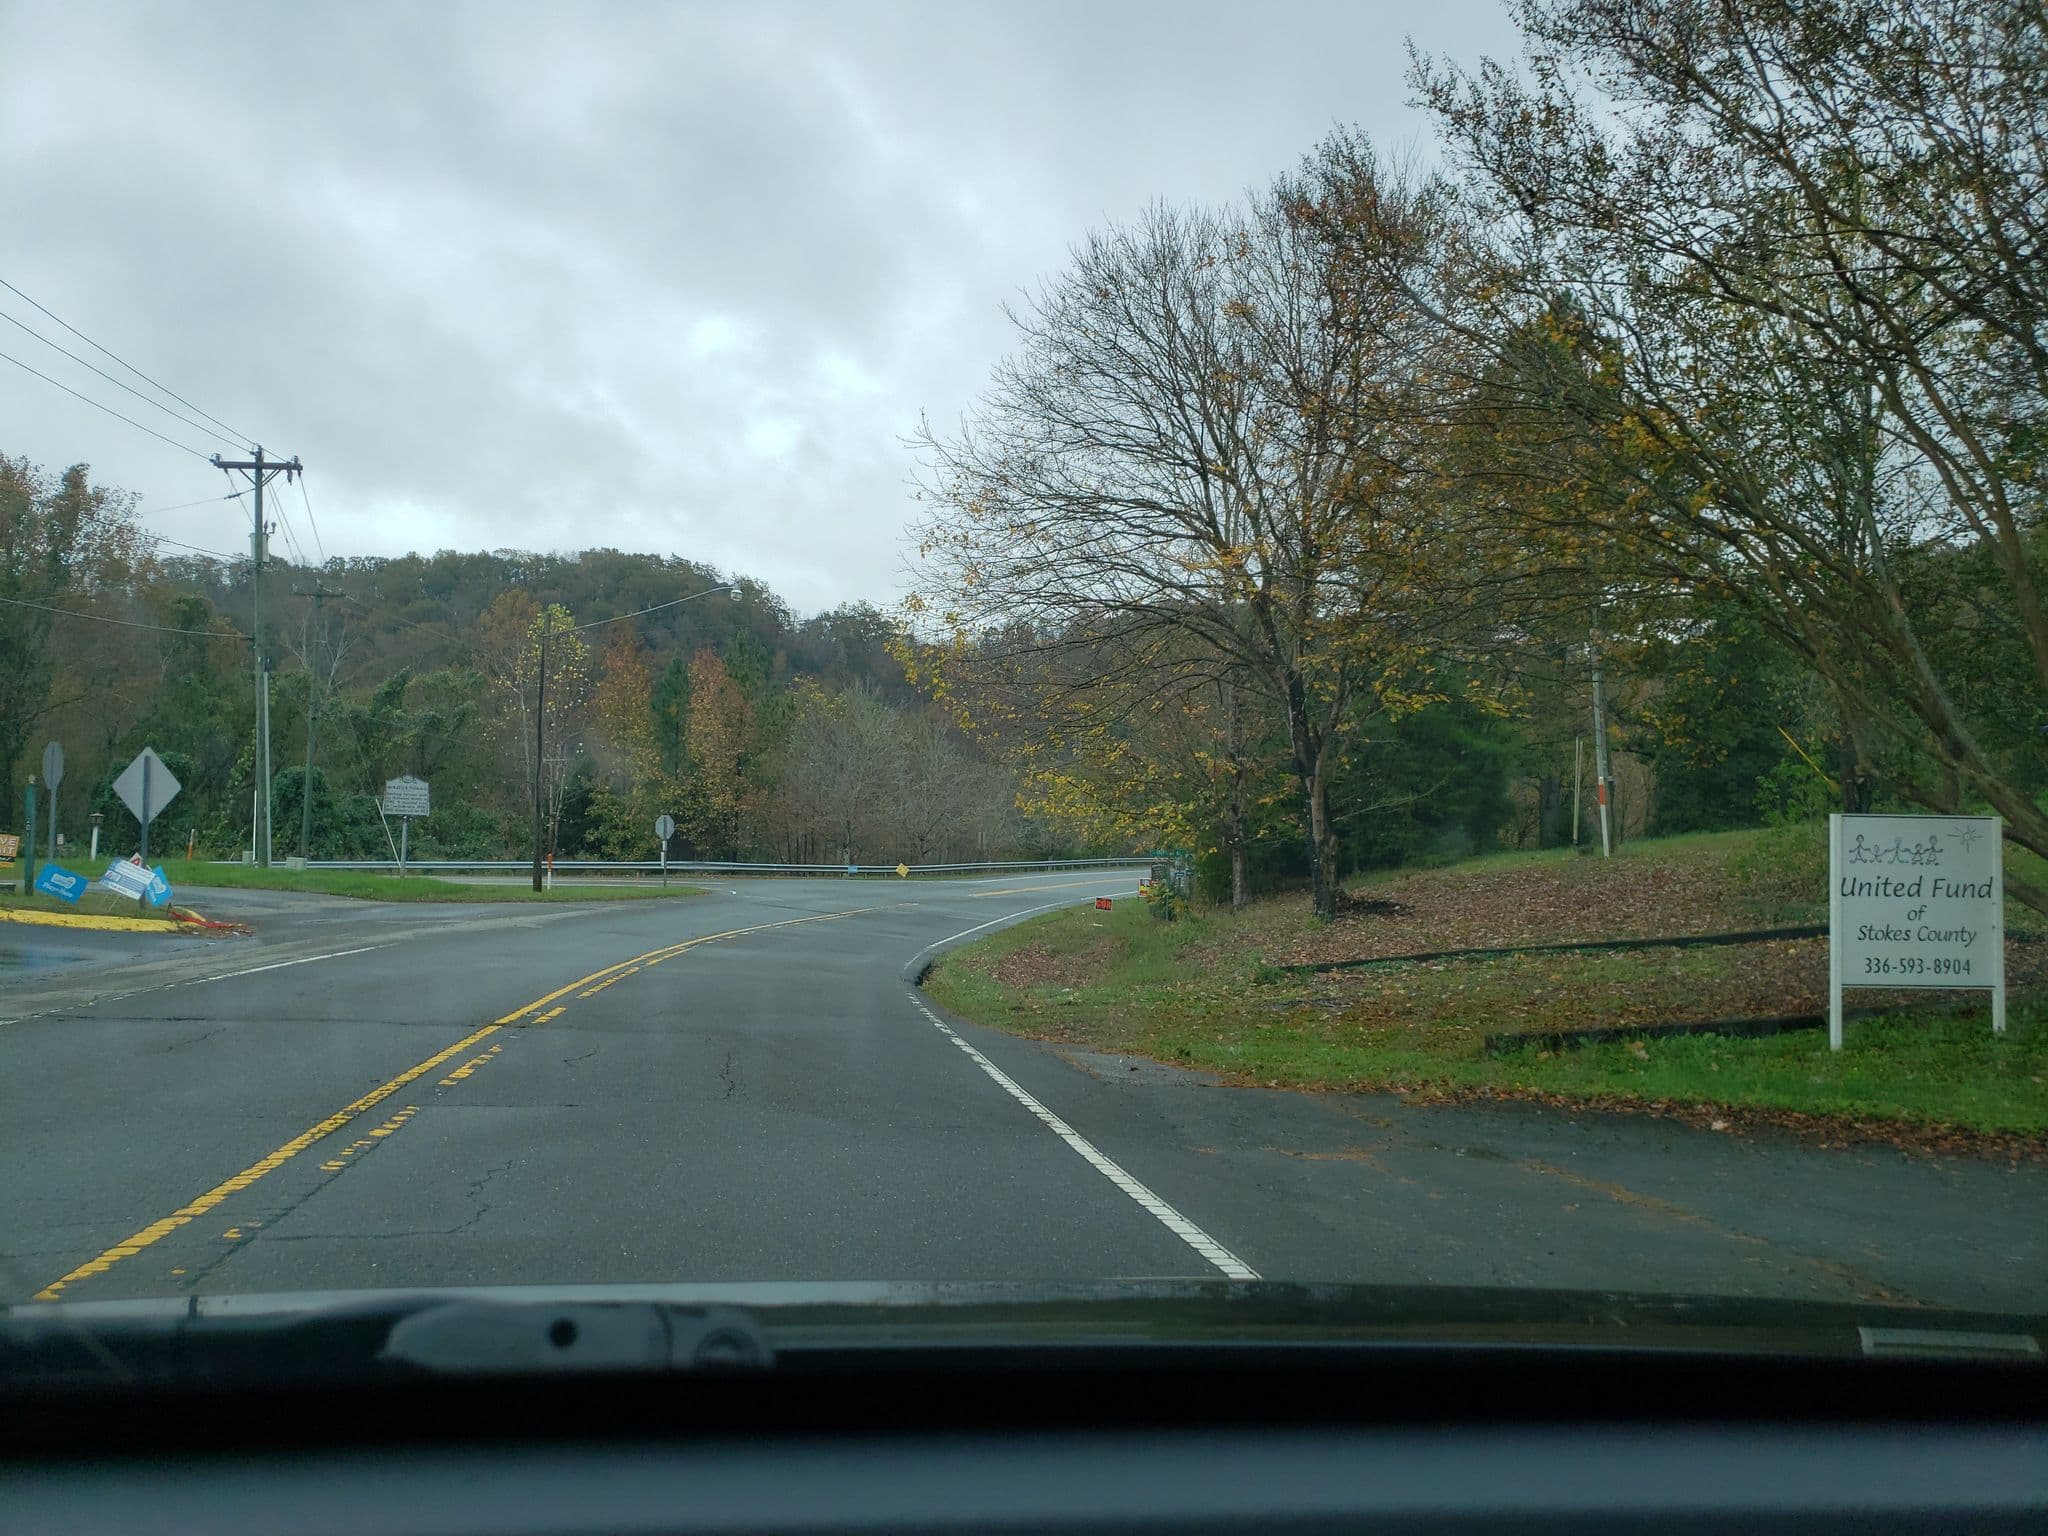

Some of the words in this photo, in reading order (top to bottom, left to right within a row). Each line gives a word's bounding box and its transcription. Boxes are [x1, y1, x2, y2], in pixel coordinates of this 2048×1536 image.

[1840, 875, 1923, 898] United
[1931, 876, 1994, 899] Fund
[1907, 905, 1927, 921] of
[1857, 924, 1911, 942] Stokes
[1917, 925, 1977, 948] County
[1864, 957, 1972, 975] 336-593-8904
